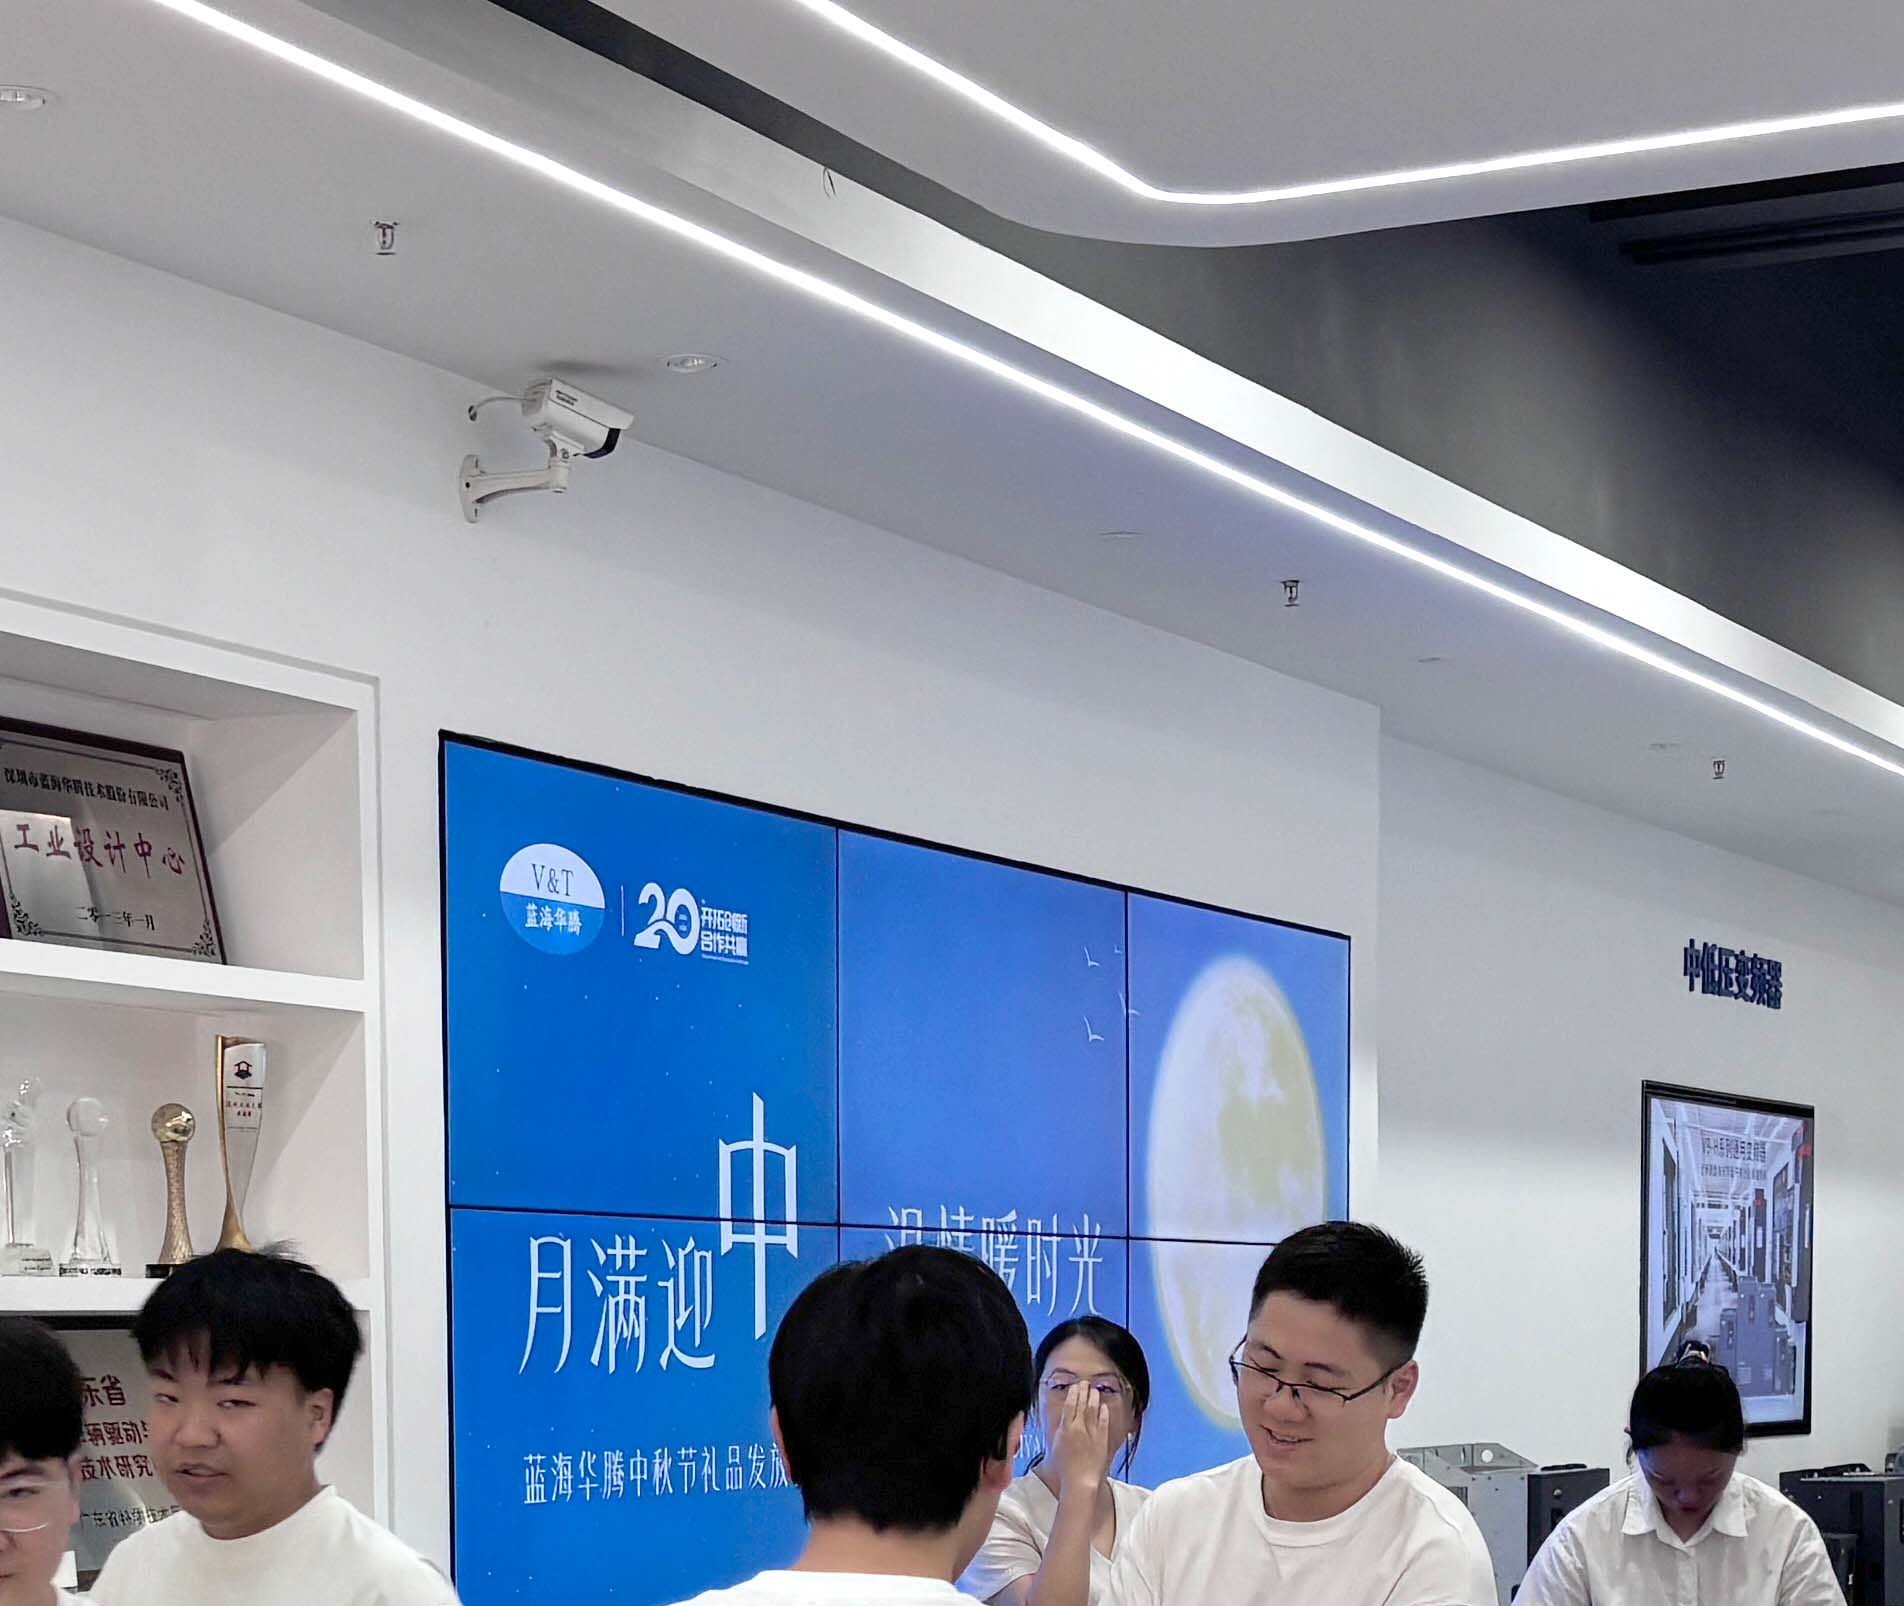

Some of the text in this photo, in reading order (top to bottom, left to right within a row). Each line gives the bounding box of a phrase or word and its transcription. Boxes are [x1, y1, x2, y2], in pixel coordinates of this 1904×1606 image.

[13, 821, 186, 879] 工业设计中心
[531, 863, 574, 897] V&T
[524, 902, 583, 936] 蓝海华腾
[633, 882, 700, 955] 20
